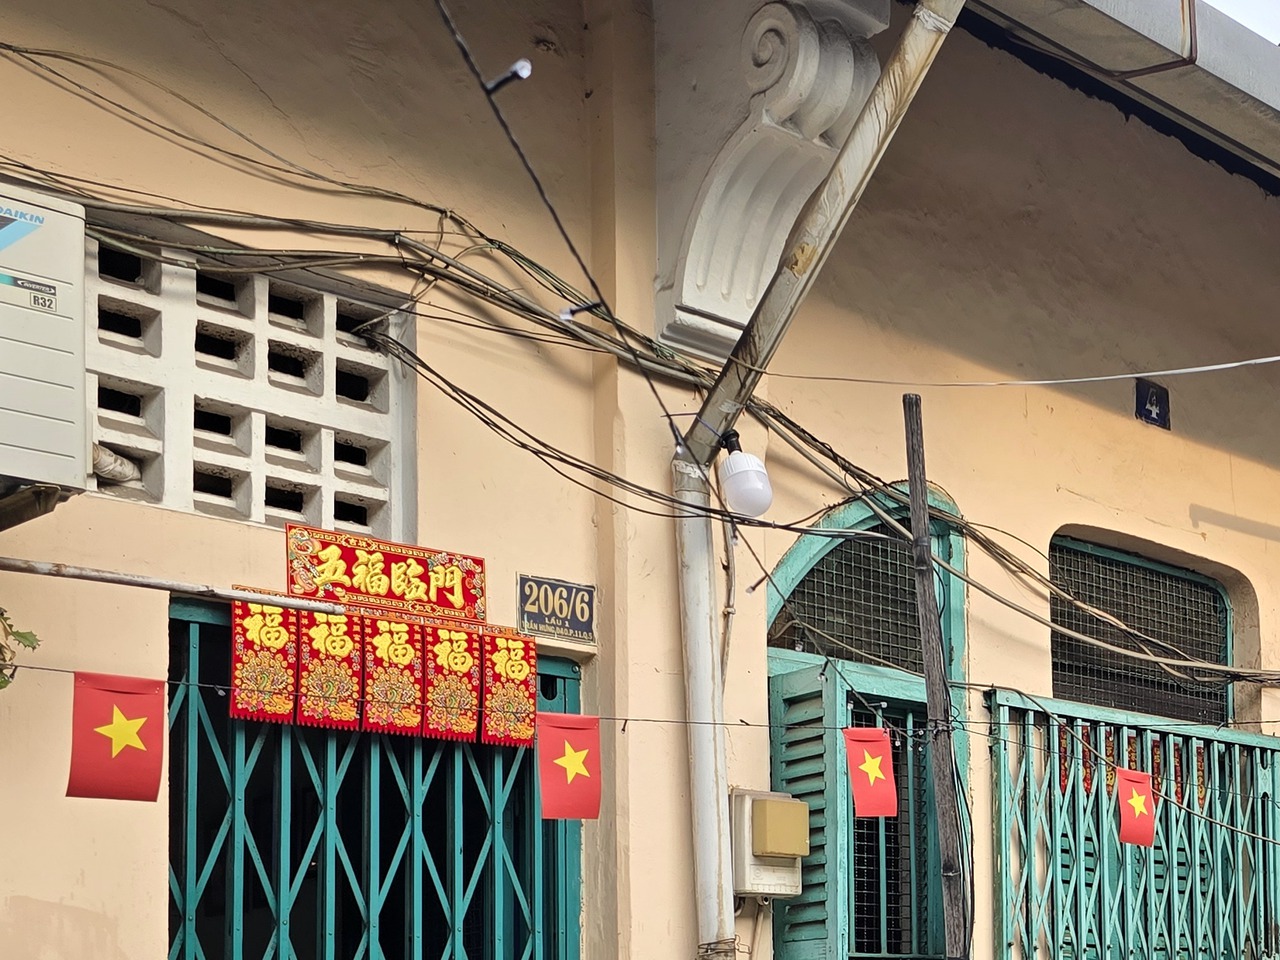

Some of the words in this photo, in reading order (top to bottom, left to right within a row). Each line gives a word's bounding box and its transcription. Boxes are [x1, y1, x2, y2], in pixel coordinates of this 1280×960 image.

[33, 295, 54, 309] R32
[313, 544, 465, 609] 五福臨門
[524, 581, 590, 622] 206/6
[308, 612, 354, 658] 福
[372, 620, 415, 666] 福
[433, 629, 474, 674] 福
[491, 637, 530, 681] 福
